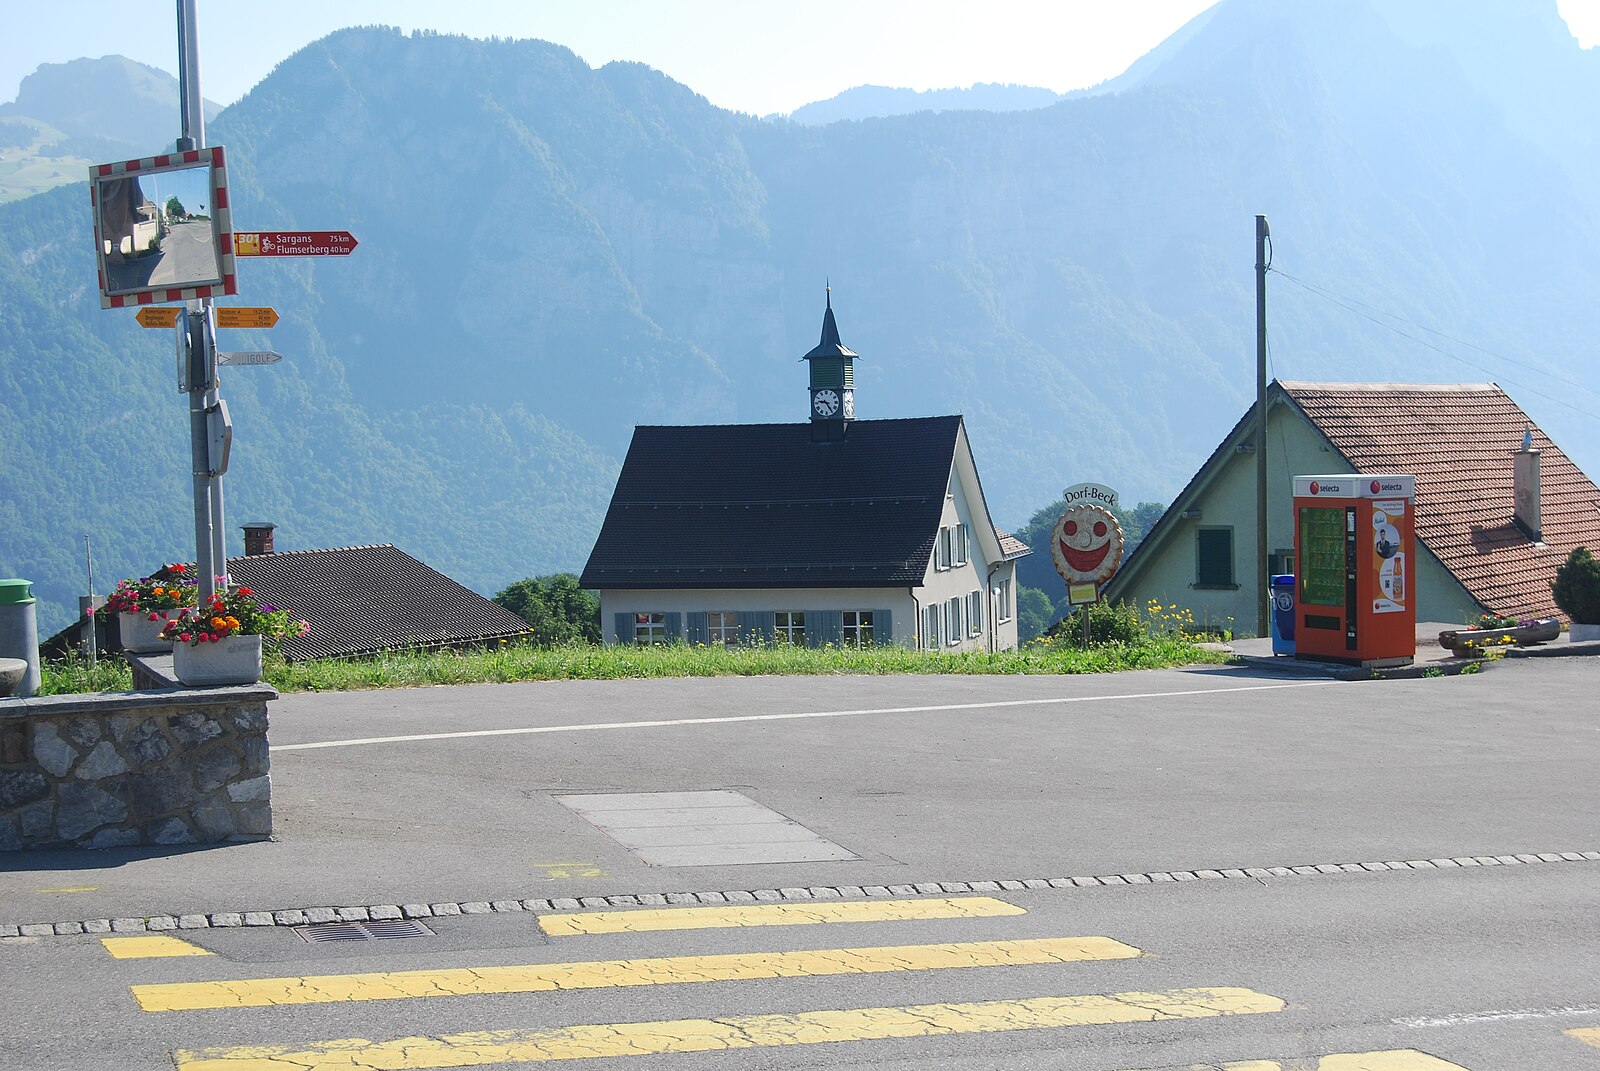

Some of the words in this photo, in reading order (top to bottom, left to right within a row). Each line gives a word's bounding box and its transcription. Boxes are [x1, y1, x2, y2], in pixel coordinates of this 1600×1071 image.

[239, 234, 259, 243] 301
[276, 234, 312, 245] Sargans
[329, 235, 338, 243] 75
[338, 235, 350, 243] km
[277, 245, 329, 255] Flumserberg
[1320, 485, 1340, 493] selecta
[1381, 483, 1402, 491] selecta
[1064, 486, 1116, 507] Dorf-Beck
